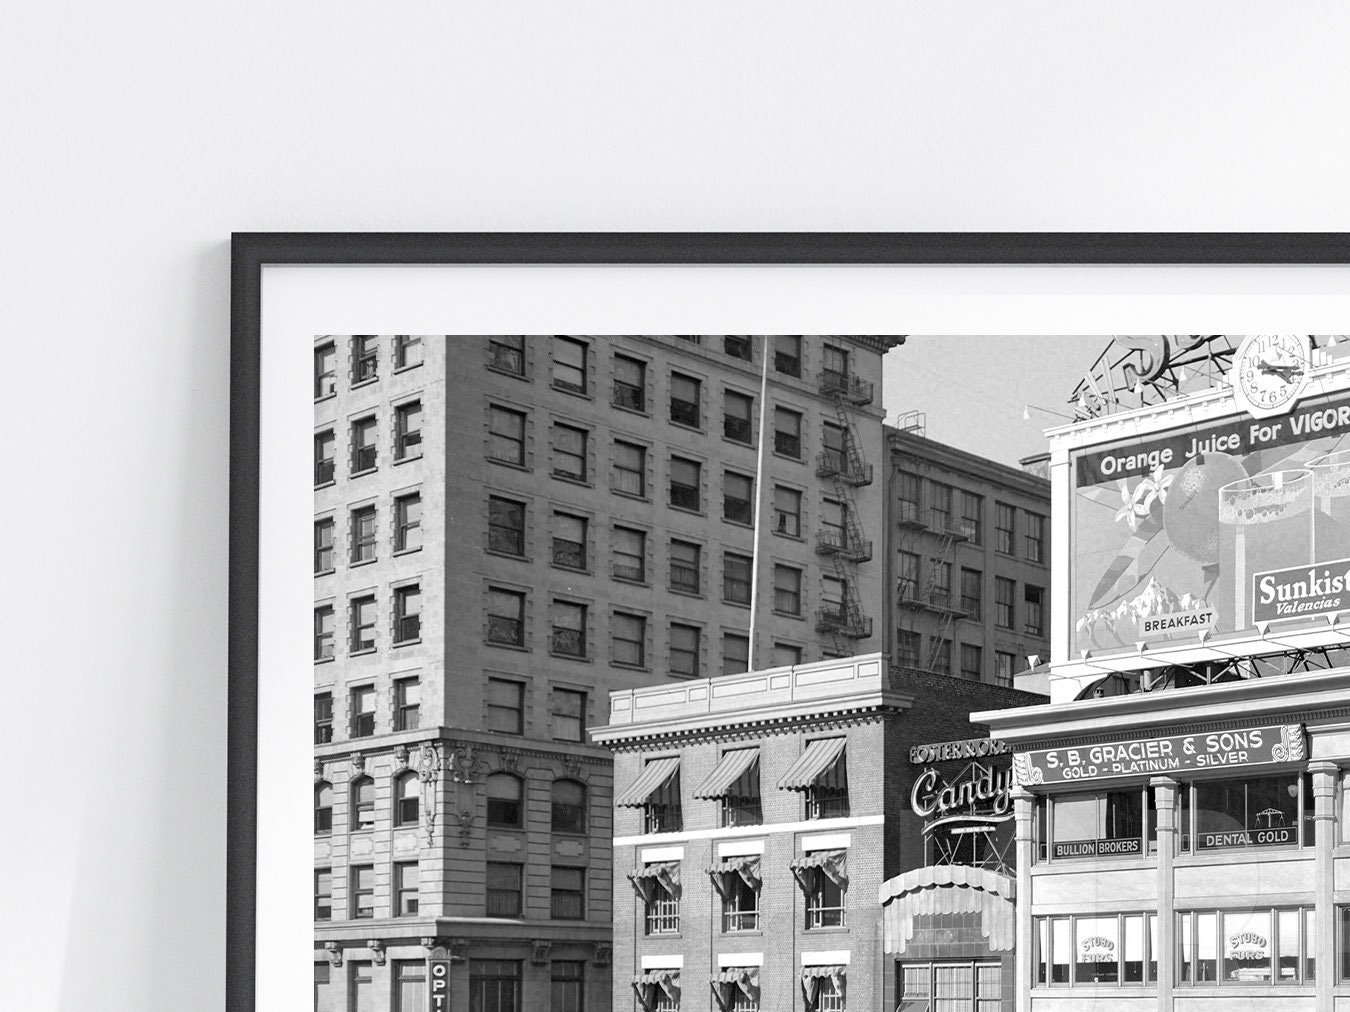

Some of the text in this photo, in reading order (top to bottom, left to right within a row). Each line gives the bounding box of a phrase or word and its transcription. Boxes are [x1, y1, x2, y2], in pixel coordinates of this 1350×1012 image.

[1101, 448, 1173, 475] Orange
[1185, 433, 1240, 458] Juice
[1250, 424, 1281, 444] For
[1275, 596, 1340, 615] Valencias
[1144, 611, 1213, 632] BREAKFAST
[1046, 730, 1263, 768] S. B. GRACIER & SONS
[1063, 766, 1097, 779] GOLD
[1112, 758, 1180, 774] PLATINUM
[1196, 751, 1249, 767] SILVER
[911, 766, 1013, 817] Candy
[1056, 840, 1139, 856] BULLION BROKERS
[1206, 830, 1289, 847] DENTAL GOLD
[1230, 949, 1265, 960] FURS
